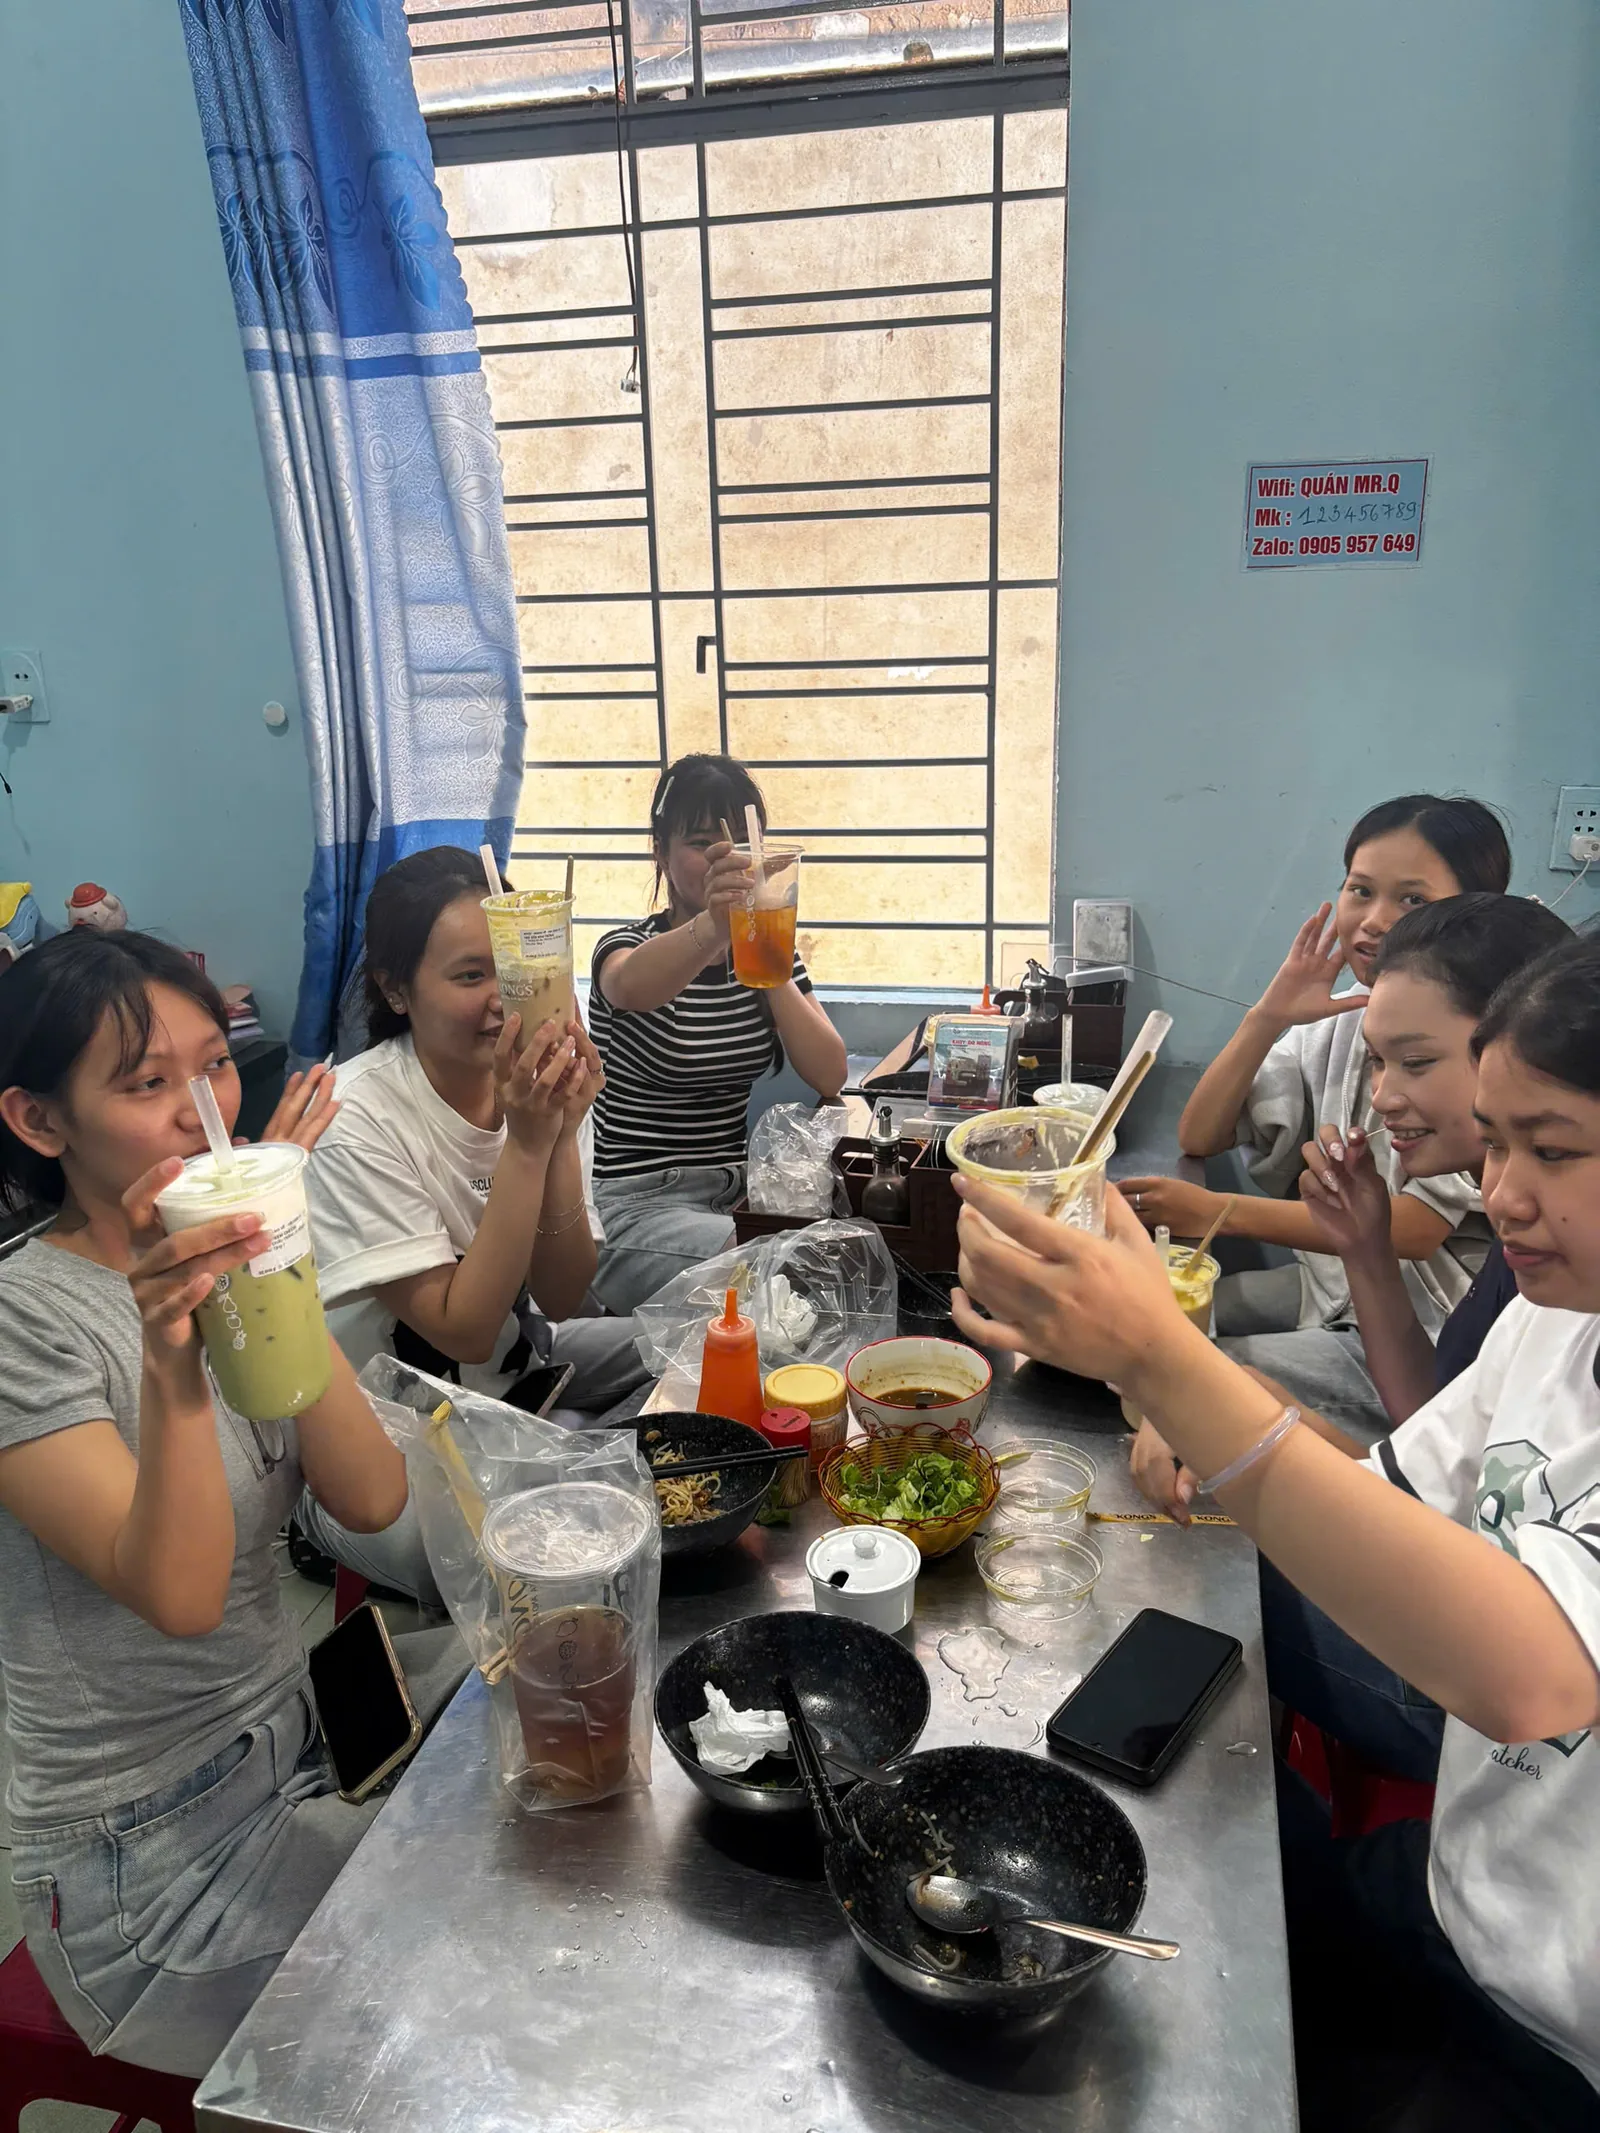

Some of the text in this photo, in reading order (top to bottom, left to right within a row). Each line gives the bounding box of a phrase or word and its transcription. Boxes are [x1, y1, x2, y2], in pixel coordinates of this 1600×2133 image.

[1258, 473, 1400, 498] Wifi: QUÁN MR.Q
[1297, 502, 1417, 526] 123456789
[1252, 533, 1416, 556] Zalo: 0905 957 649
